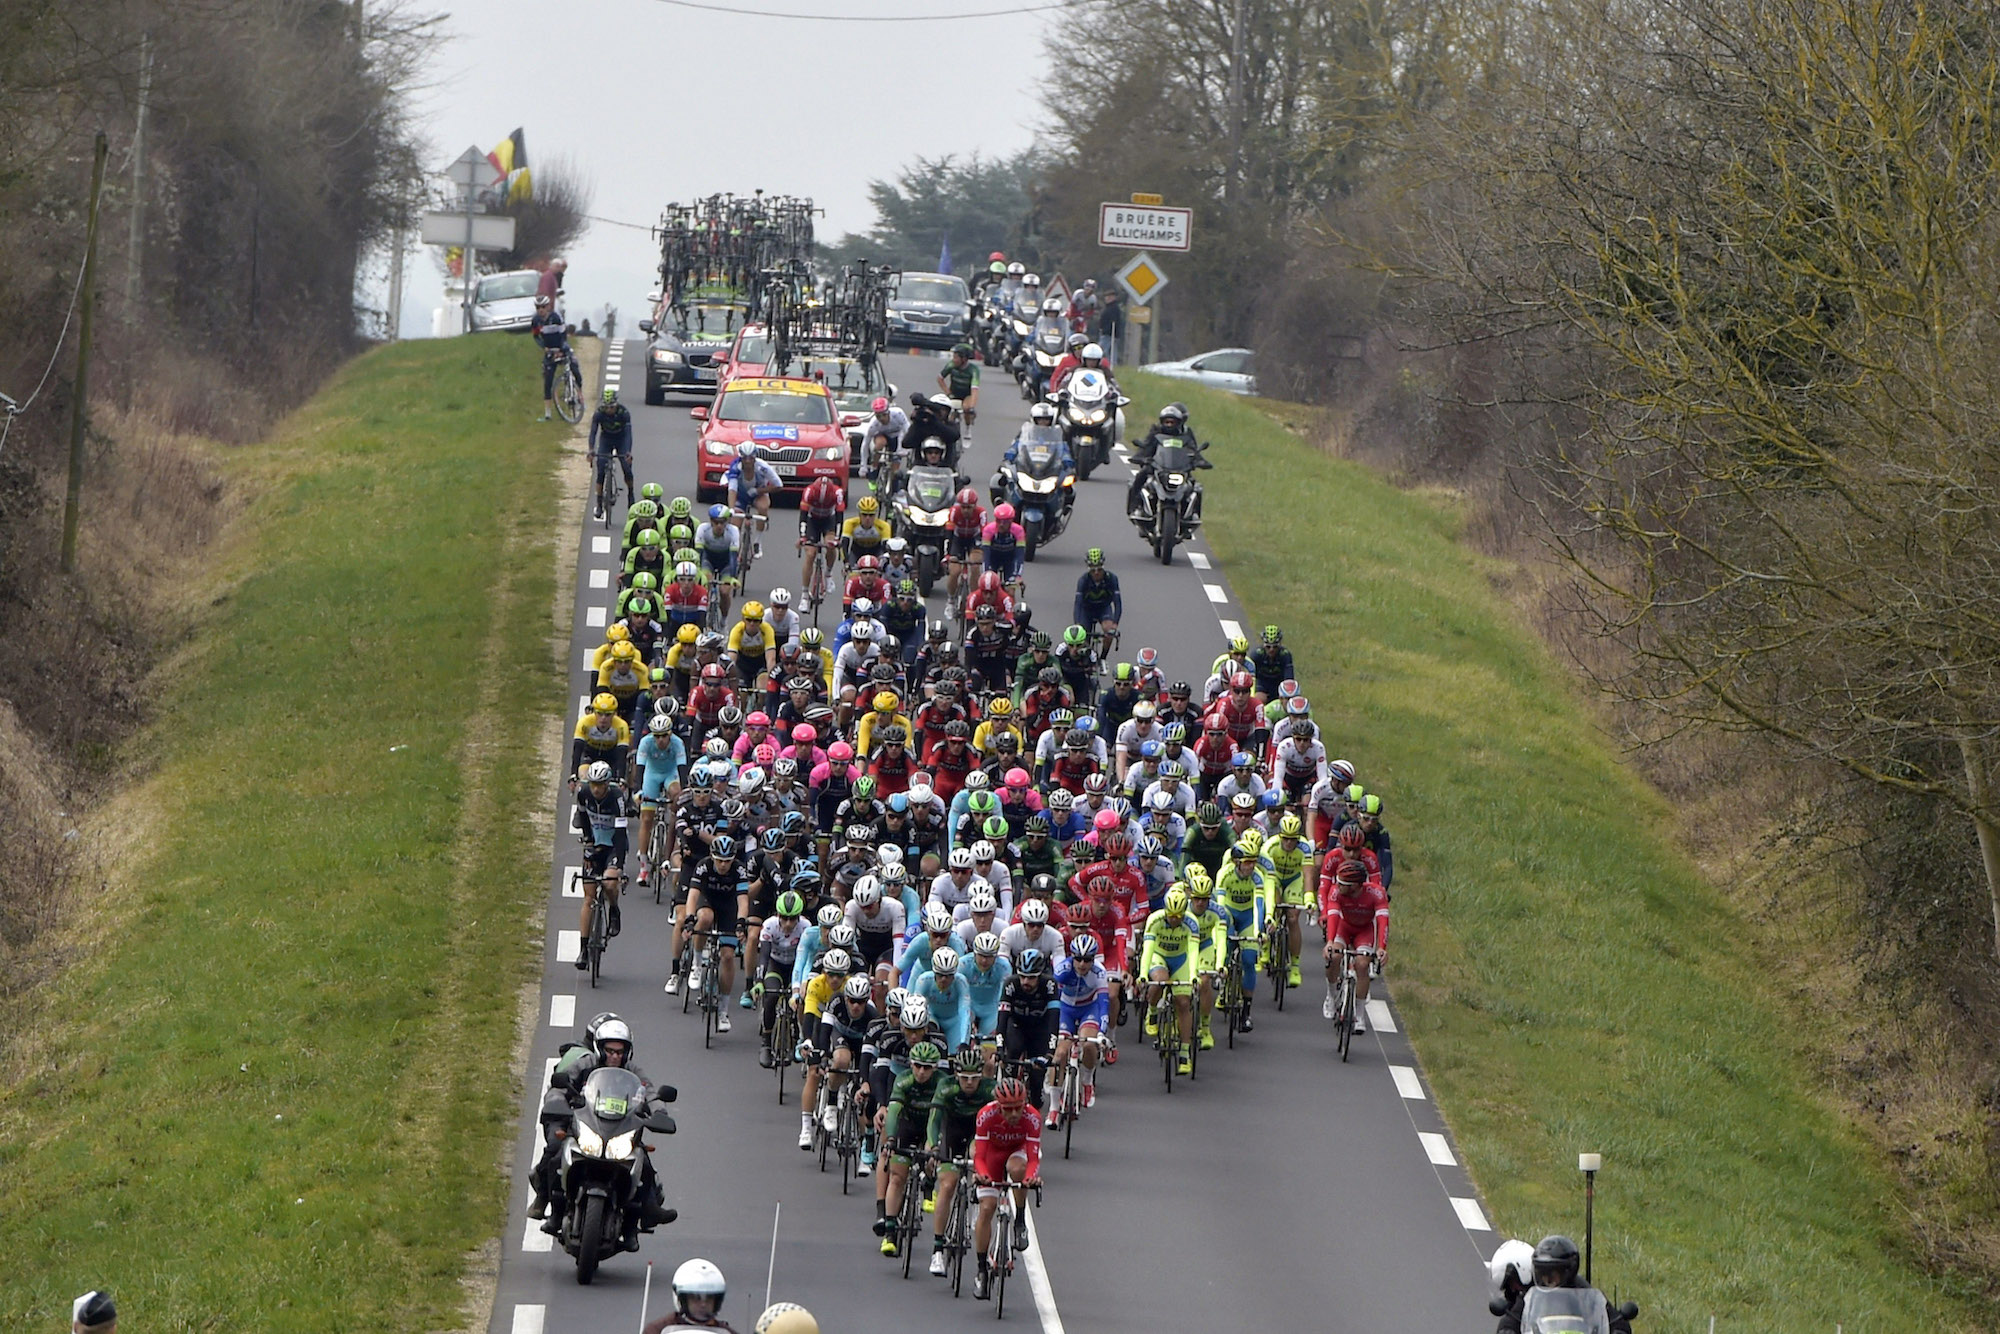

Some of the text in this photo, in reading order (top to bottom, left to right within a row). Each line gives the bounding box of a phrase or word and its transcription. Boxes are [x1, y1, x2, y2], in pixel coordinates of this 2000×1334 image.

[1108, 227, 1183, 242] ALLICHAMPS
[757, 380, 793, 389] LCL
[755, 426, 784, 436] france
